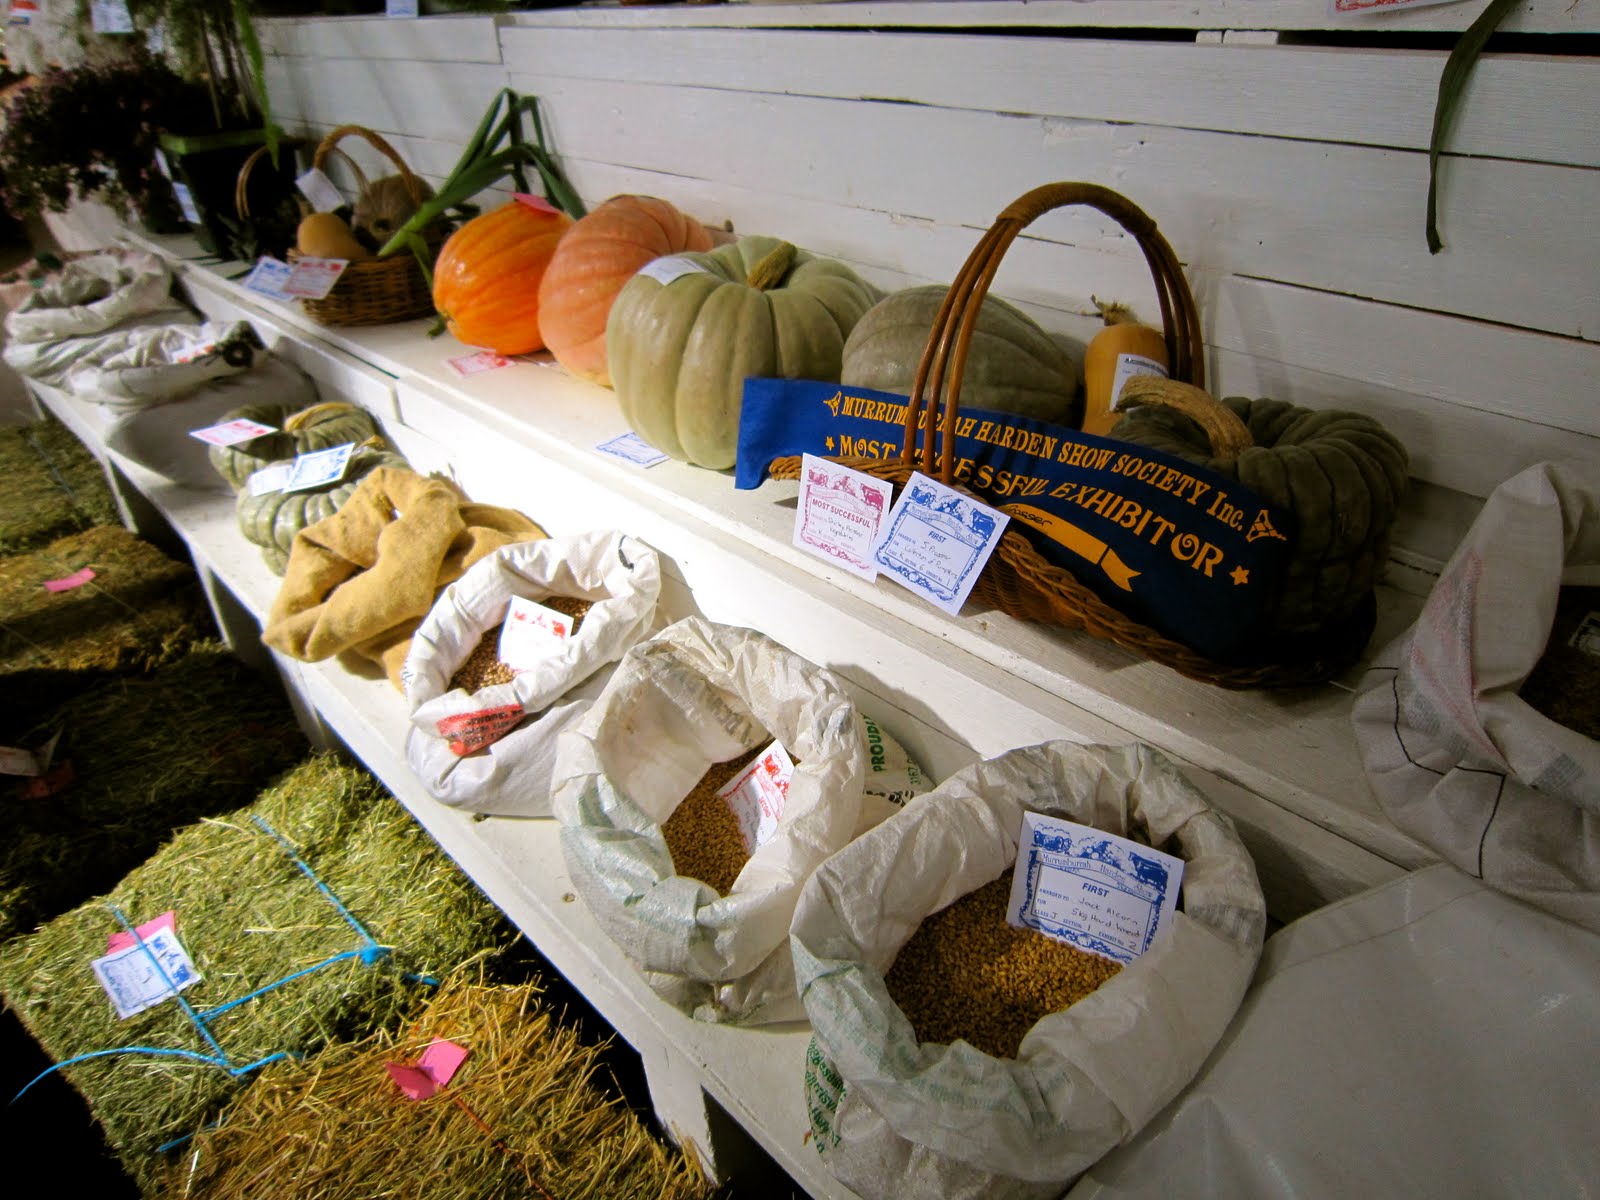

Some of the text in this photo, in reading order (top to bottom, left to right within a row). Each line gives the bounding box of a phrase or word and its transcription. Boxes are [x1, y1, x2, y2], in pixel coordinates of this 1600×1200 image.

[975, 420, 1059, 460] HARDEN
[1057, 441, 1117, 471] SHOW
[1112, 457, 1211, 507] SOCIETY
[1206, 491, 1244, 532] Inc.
[812, 498, 830, 512] MOST
[830, 504, 871, 529] SUCCESSFUL
[839, 434, 1224, 578] MOST ESSFUL EXHIBITOR
[928, 530, 947, 543] FIRST
[1082, 882, 1109, 898] FIRST
[1129, 941, 1137, 950] 2
